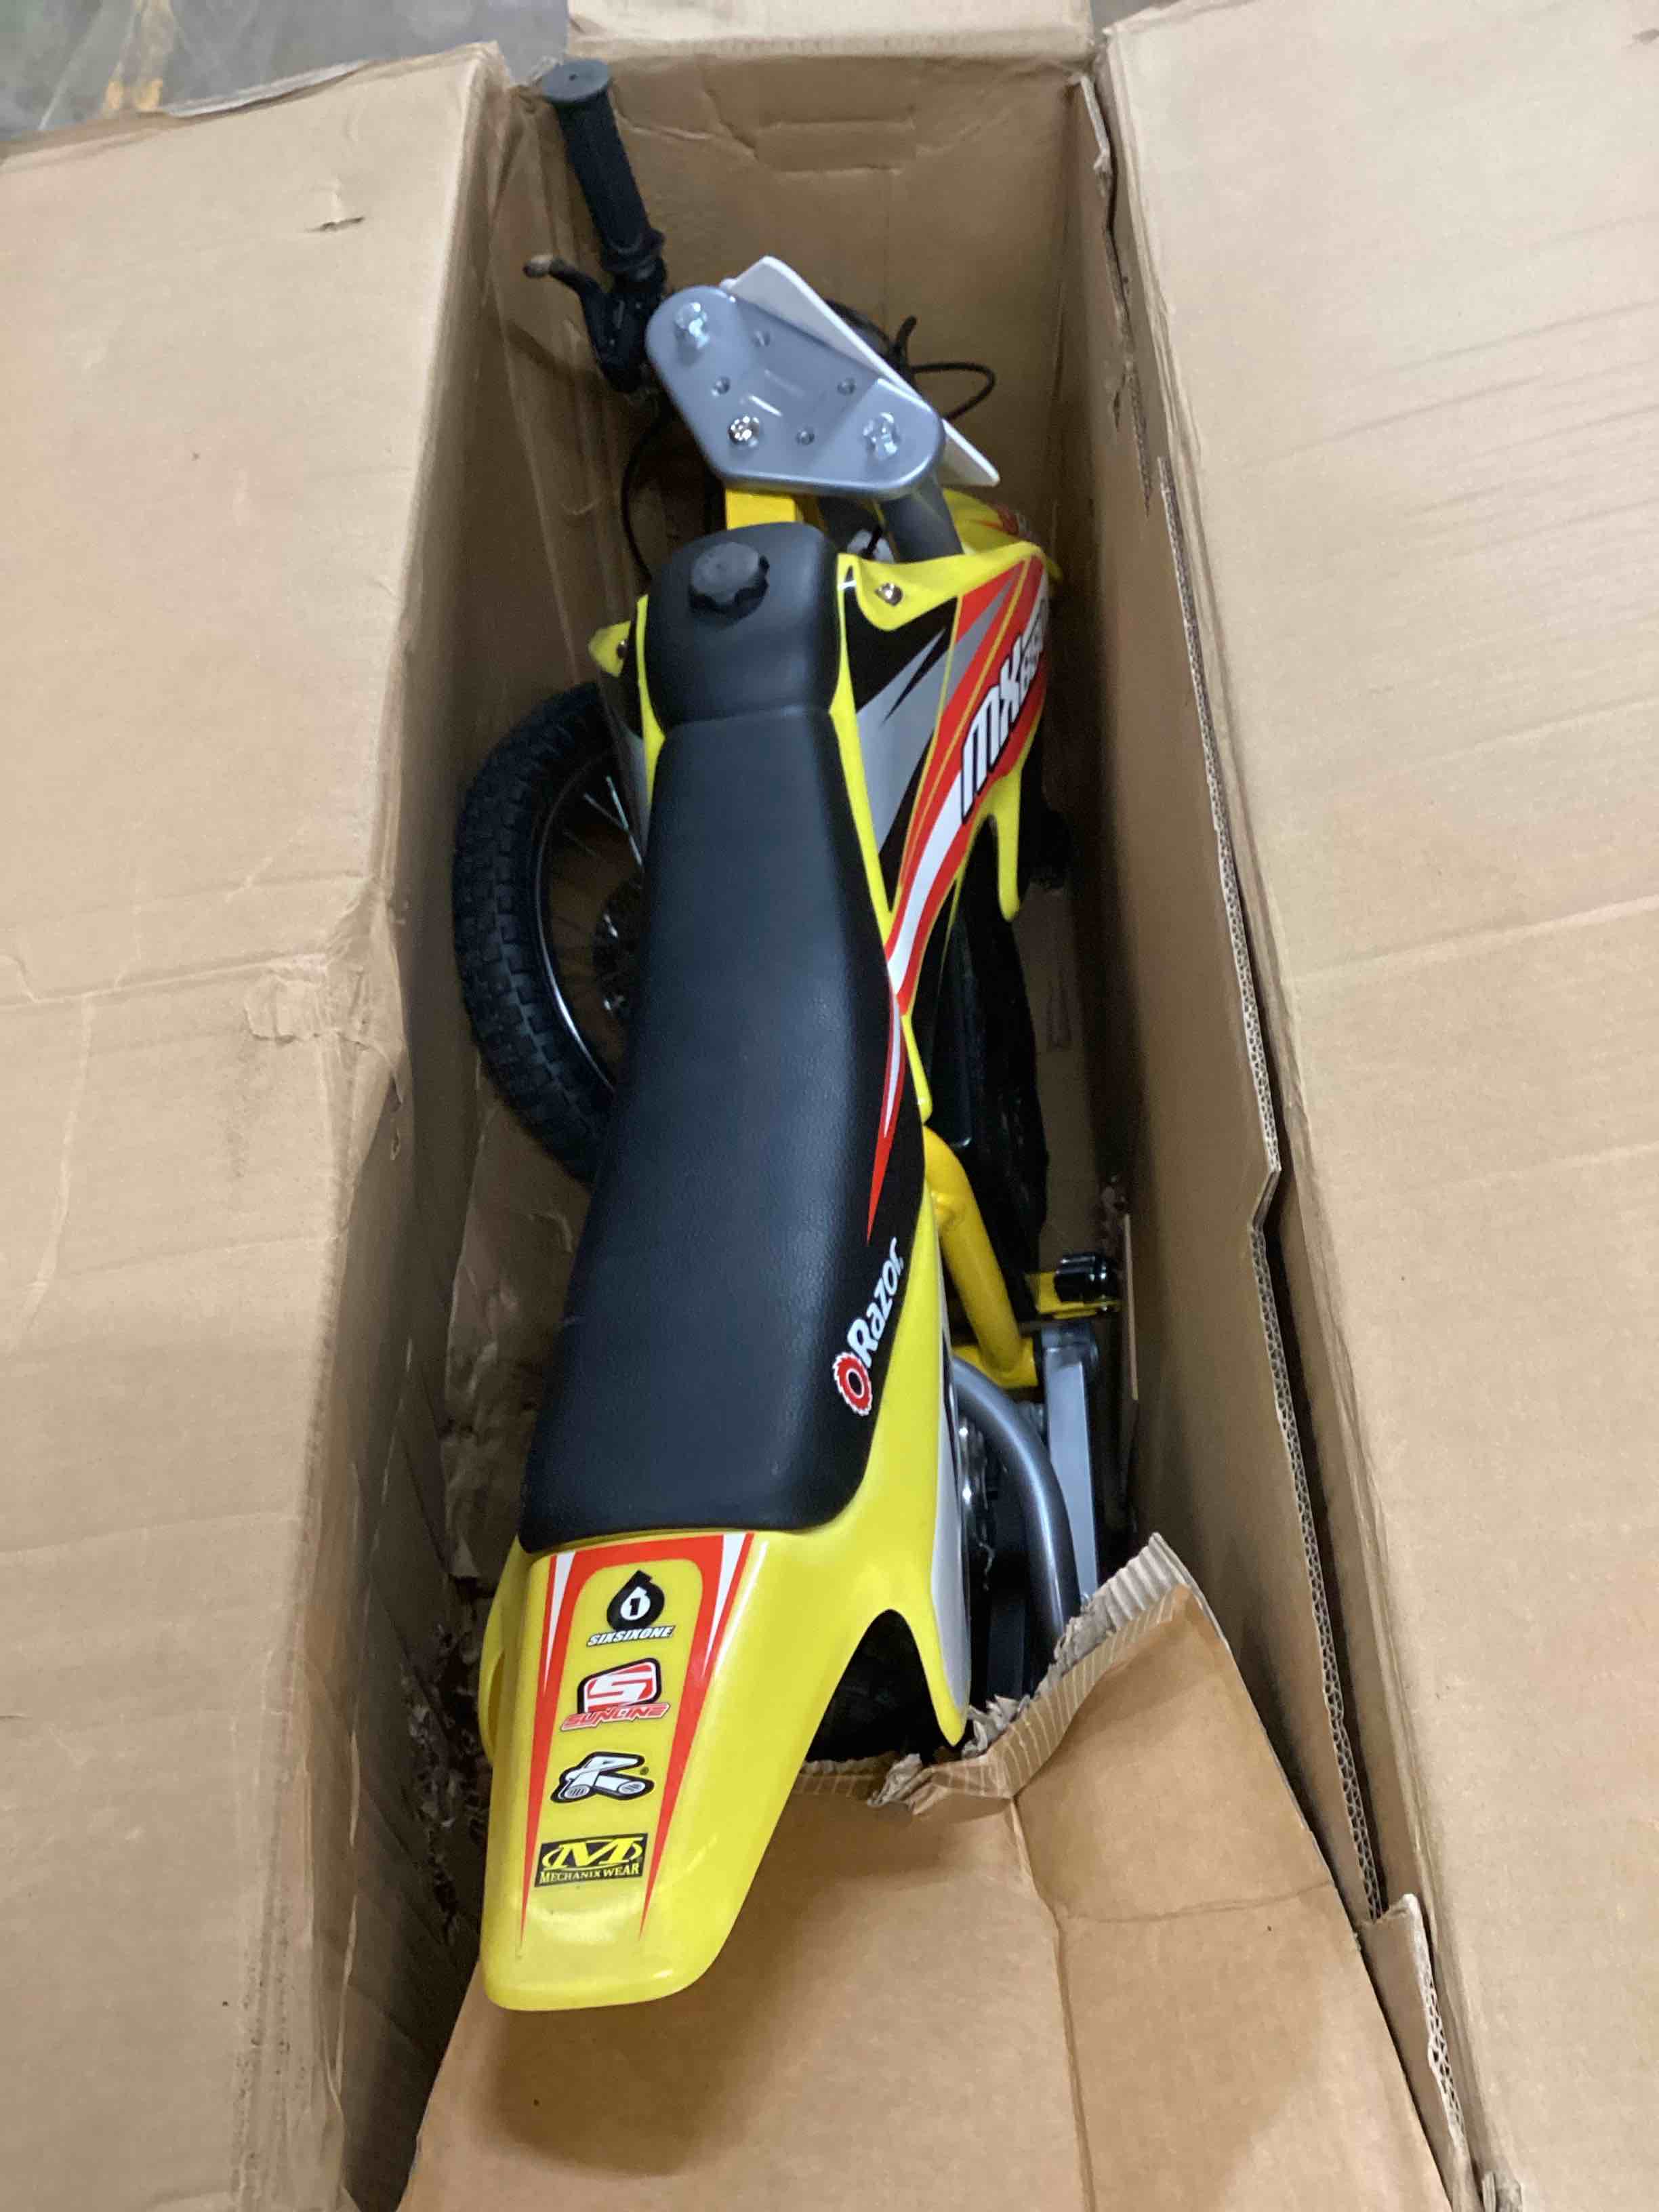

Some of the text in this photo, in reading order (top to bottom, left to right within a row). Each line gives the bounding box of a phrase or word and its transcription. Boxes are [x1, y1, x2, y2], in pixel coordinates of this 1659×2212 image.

[846, 1236, 904, 1368] Razor
[588, 1626, 676, 1647] SIXSIXONE
[539, 1863, 640, 1884] MECHANIX WEAR
